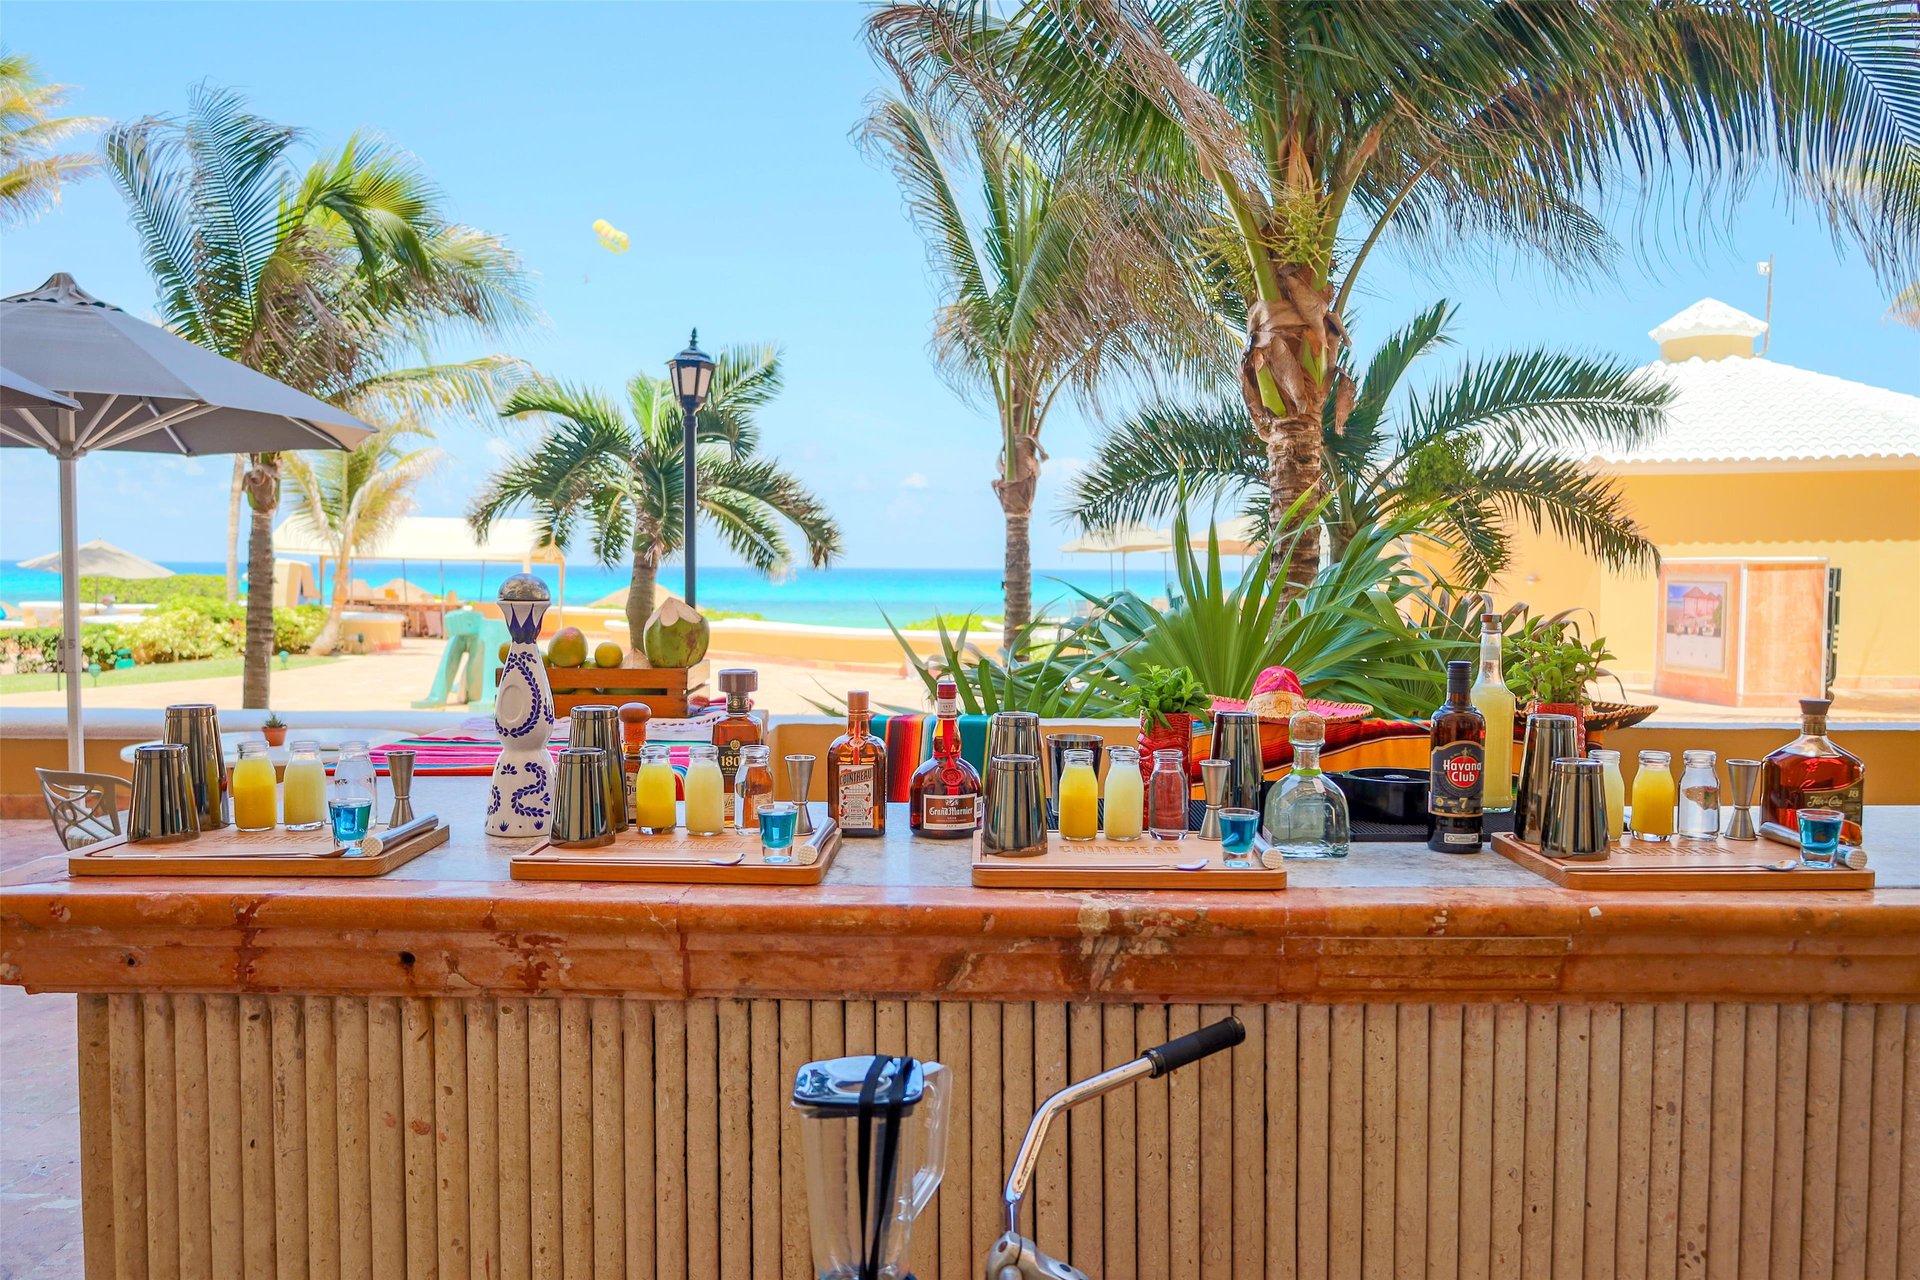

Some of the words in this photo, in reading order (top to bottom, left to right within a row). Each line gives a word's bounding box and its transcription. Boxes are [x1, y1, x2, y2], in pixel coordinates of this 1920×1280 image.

[1443, 759, 1482, 771] Havana
[840, 768, 872, 785] COINTREAU
[1451, 771, 1475, 782] Club
[1459, 797, 1468, 809] 7
[929, 806, 948, 816] Grand
[948, 806, 973, 816] Marnier
[1059, 845, 1181, 854] COINTREAU
